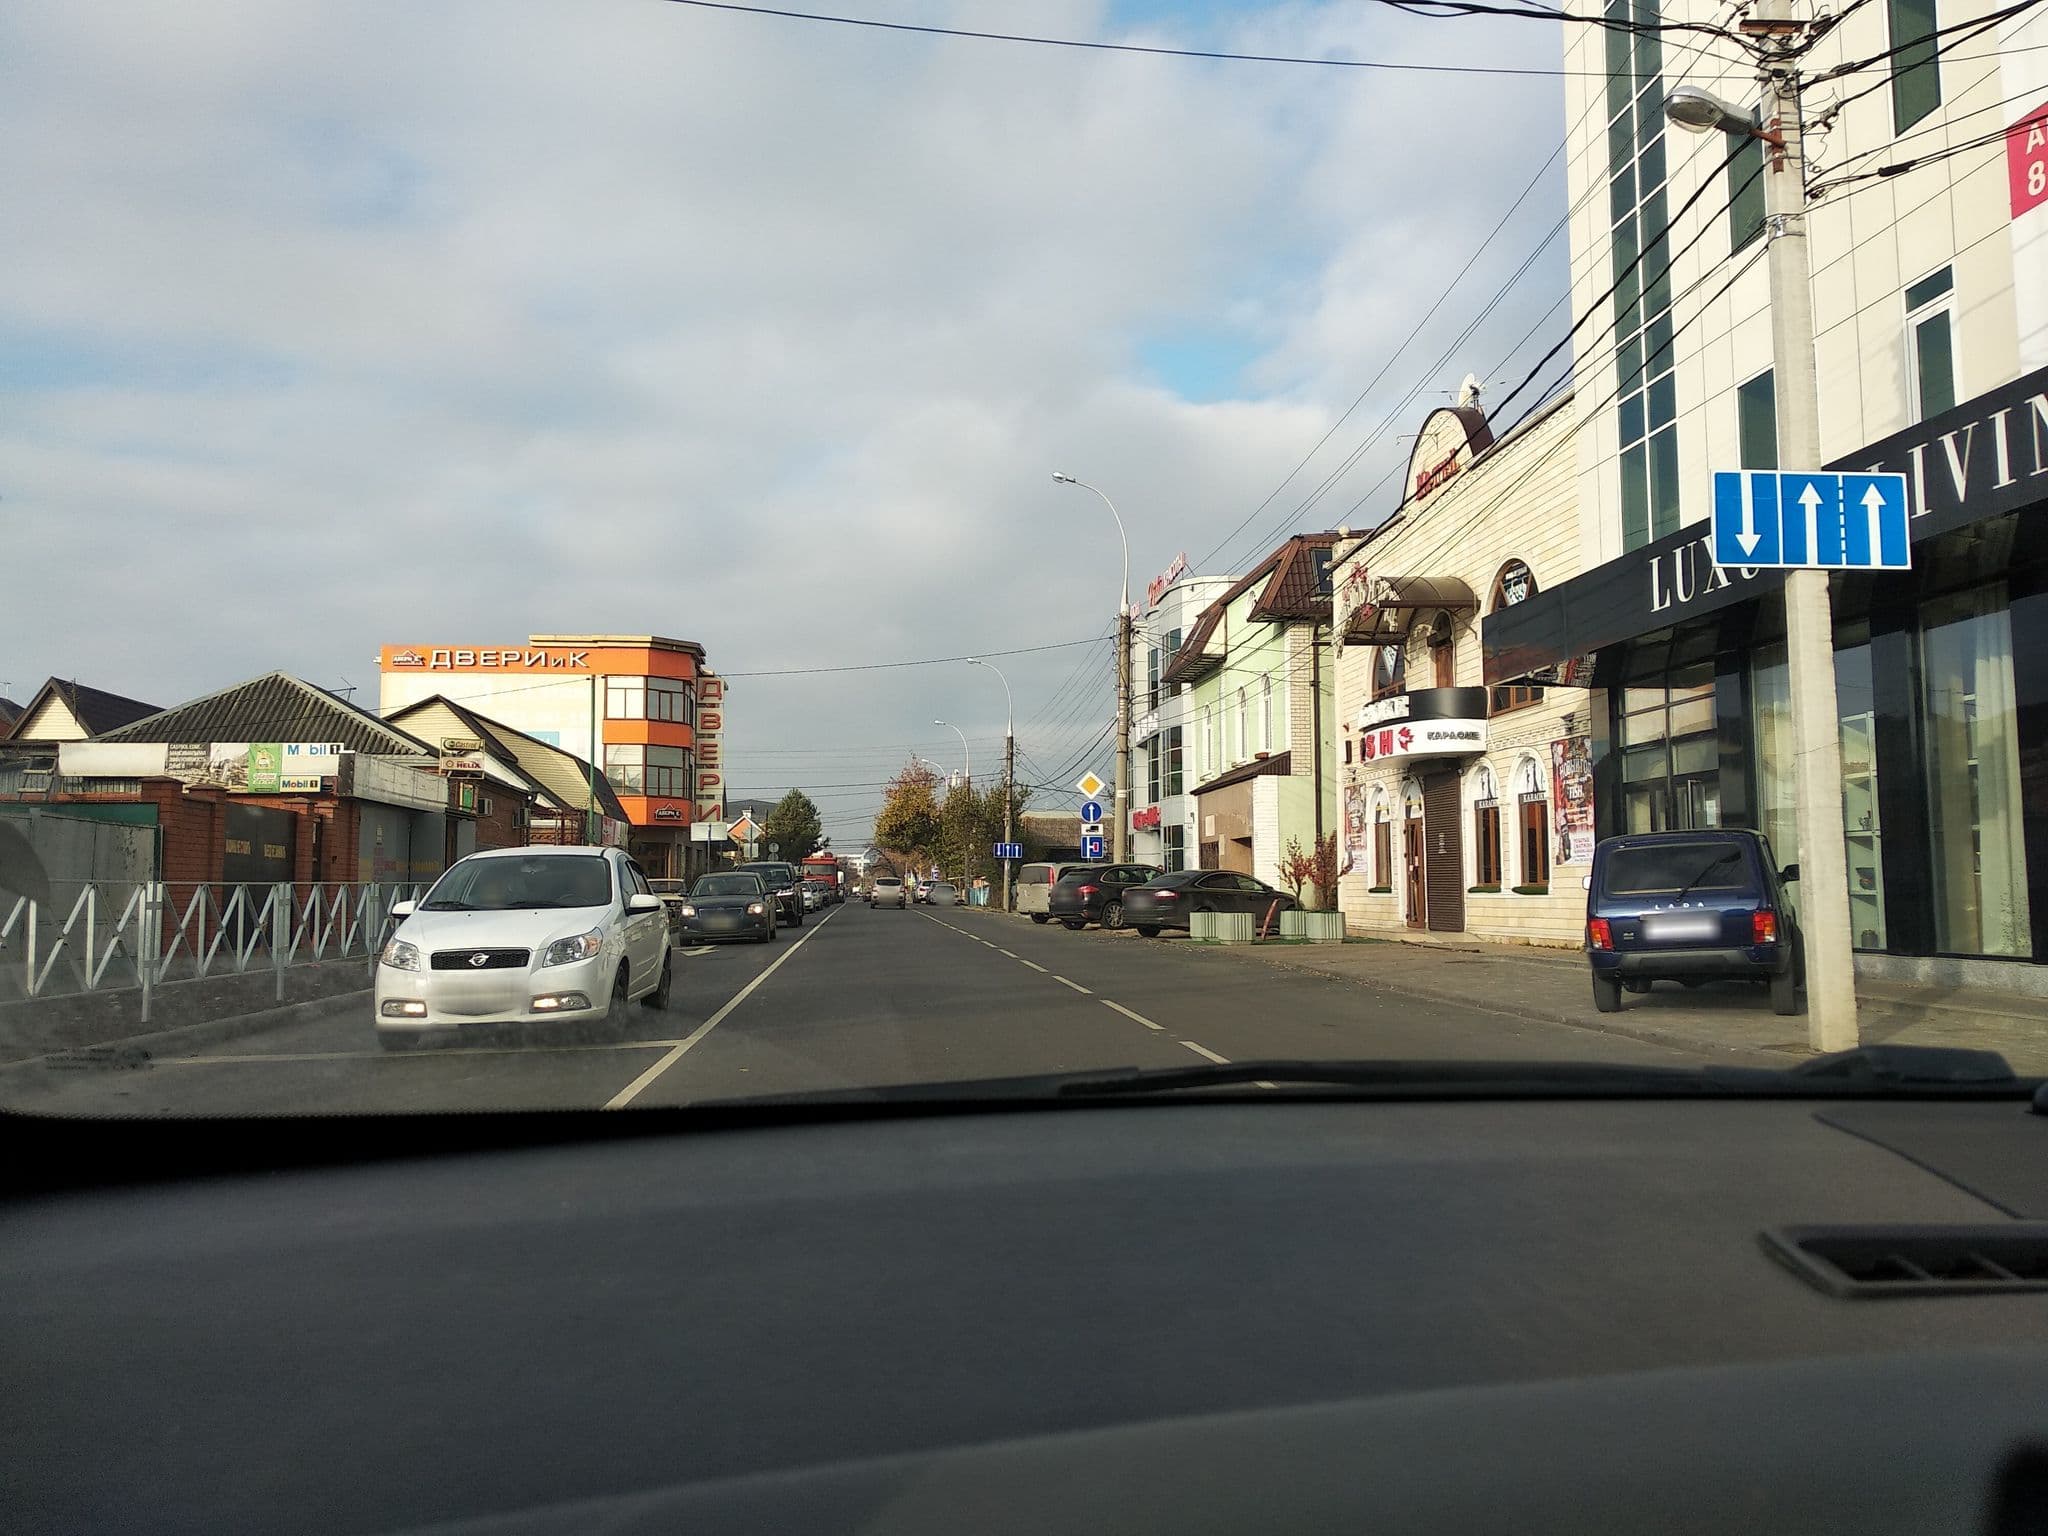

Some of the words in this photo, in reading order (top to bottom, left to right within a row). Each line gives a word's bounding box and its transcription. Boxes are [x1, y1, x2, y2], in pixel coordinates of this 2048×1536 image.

[2026, 118, 2048, 155] А
[1866, 394, 2048, 519] IVIN
[287, 745, 327, 755] Mbil
[281, 780, 308, 789] Mobil
[310, 780, 318, 788] 1
[1655, 902, 1704, 910] LADA
